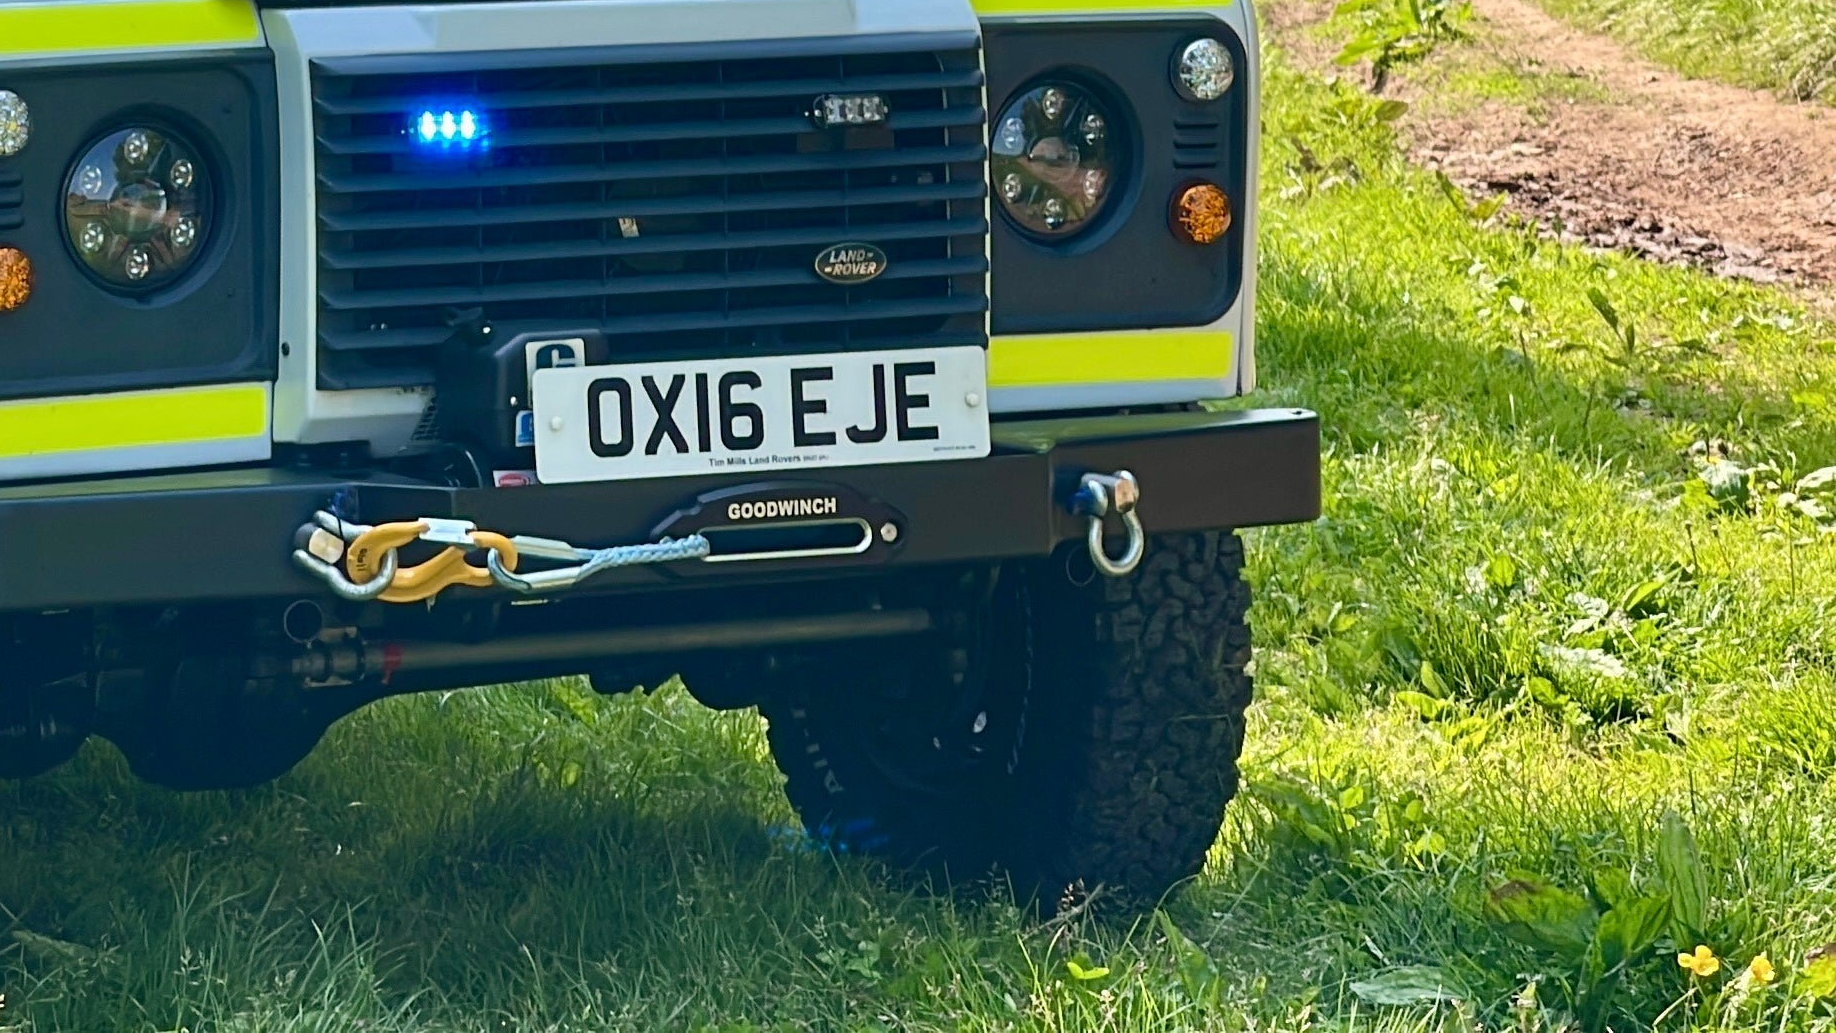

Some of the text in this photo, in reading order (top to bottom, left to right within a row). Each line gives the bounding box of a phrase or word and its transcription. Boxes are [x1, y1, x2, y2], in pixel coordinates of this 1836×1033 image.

[587, 361, 940, 458] OX16 EJE
[709, 458, 725, 467] Tim
[727, 456, 746, 466] Mills
[748, 455, 770, 465] Land
[772, 454, 801, 464] Rovers
[728, 497, 837, 520] GOODWINCH
